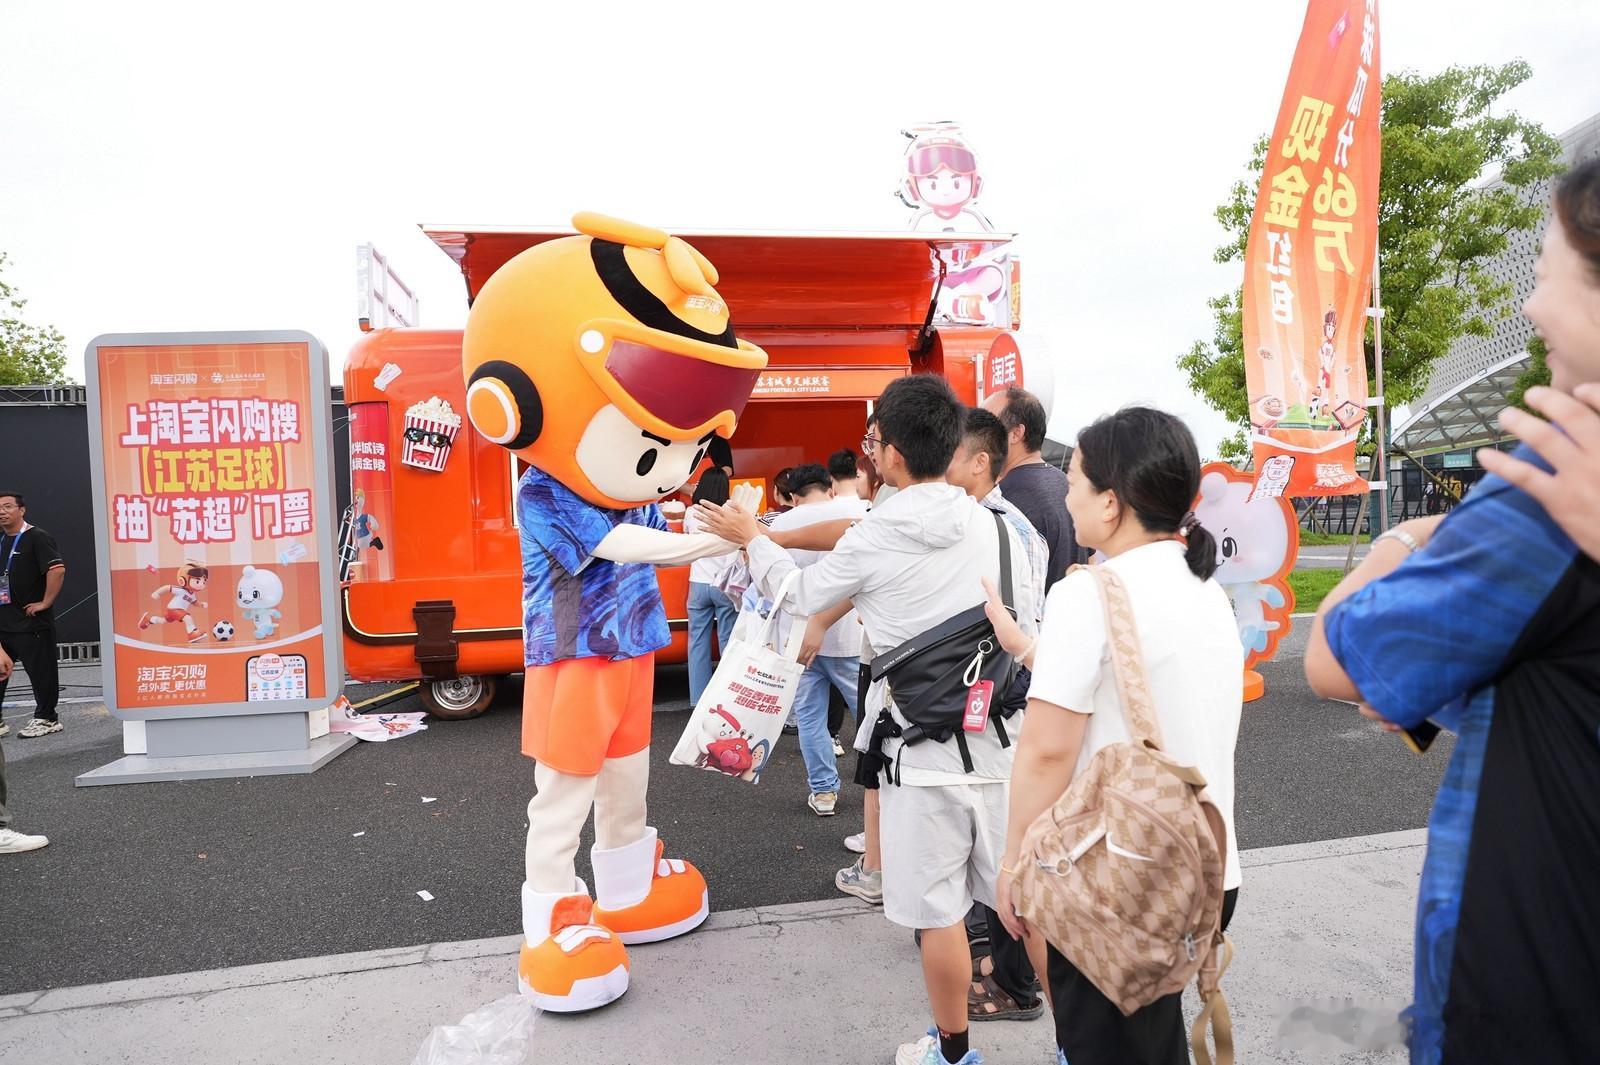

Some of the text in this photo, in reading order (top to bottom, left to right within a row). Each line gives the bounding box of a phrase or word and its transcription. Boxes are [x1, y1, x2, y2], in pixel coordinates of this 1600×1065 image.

[991, 351, 1016, 388] 淘宝
[122, 398, 299, 446] 上淘宝闪购搜
[136, 663, 207, 682] 淘宝闪购
